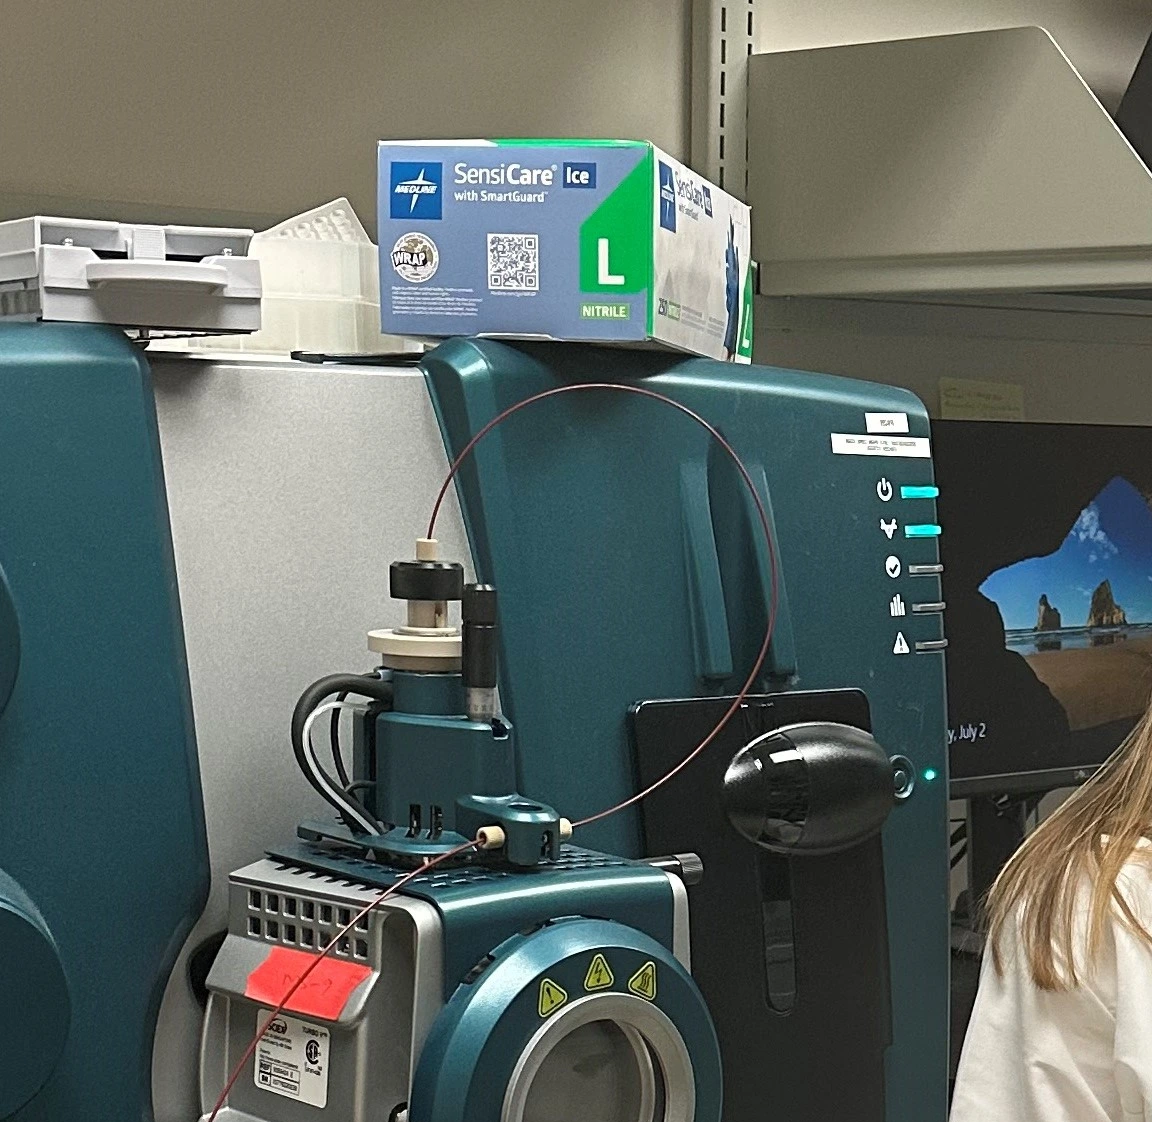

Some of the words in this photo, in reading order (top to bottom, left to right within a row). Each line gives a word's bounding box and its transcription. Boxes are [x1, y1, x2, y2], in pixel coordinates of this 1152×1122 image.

[566, 166, 590, 185] Ice
[394, 185, 438, 194] MEDLINE
[454, 190, 478, 203] with
[393, 251, 426, 266] WRAP
[598, 238, 625, 285] L
[582, 305, 628, 318] NITRILE
[959, 724, 977, 743] July
[979, 722, 986, 738] 2
